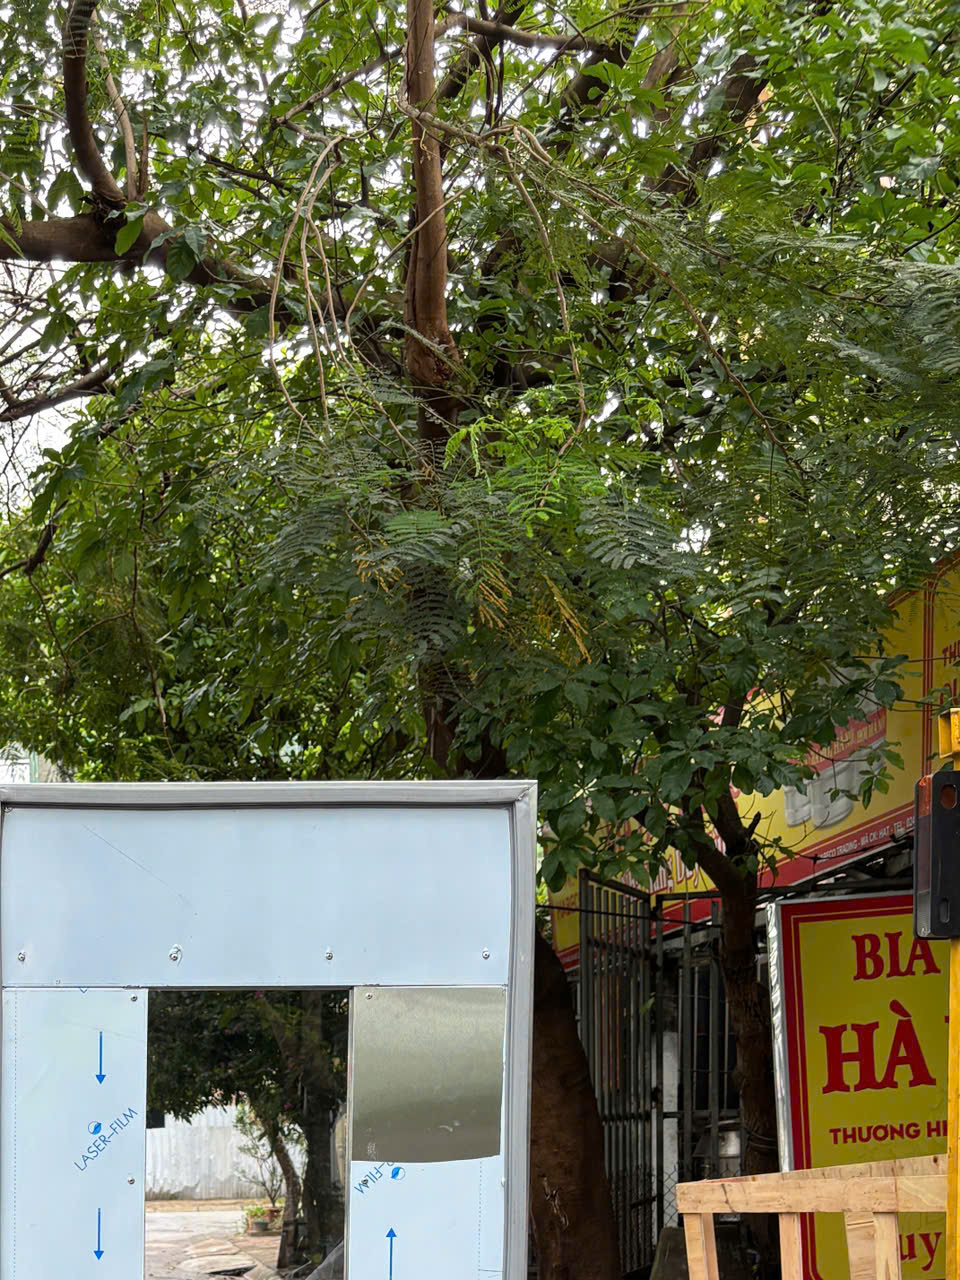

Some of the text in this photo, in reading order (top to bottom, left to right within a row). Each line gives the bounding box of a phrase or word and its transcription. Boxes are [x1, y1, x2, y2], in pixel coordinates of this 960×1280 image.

[851, 930, 941, 981] BIA
[819, 999, 937, 1095] HÀ
[74, 1107, 138, 1171] LASER-FILM
[829, 1120, 921, 1145] THƯƠNG
